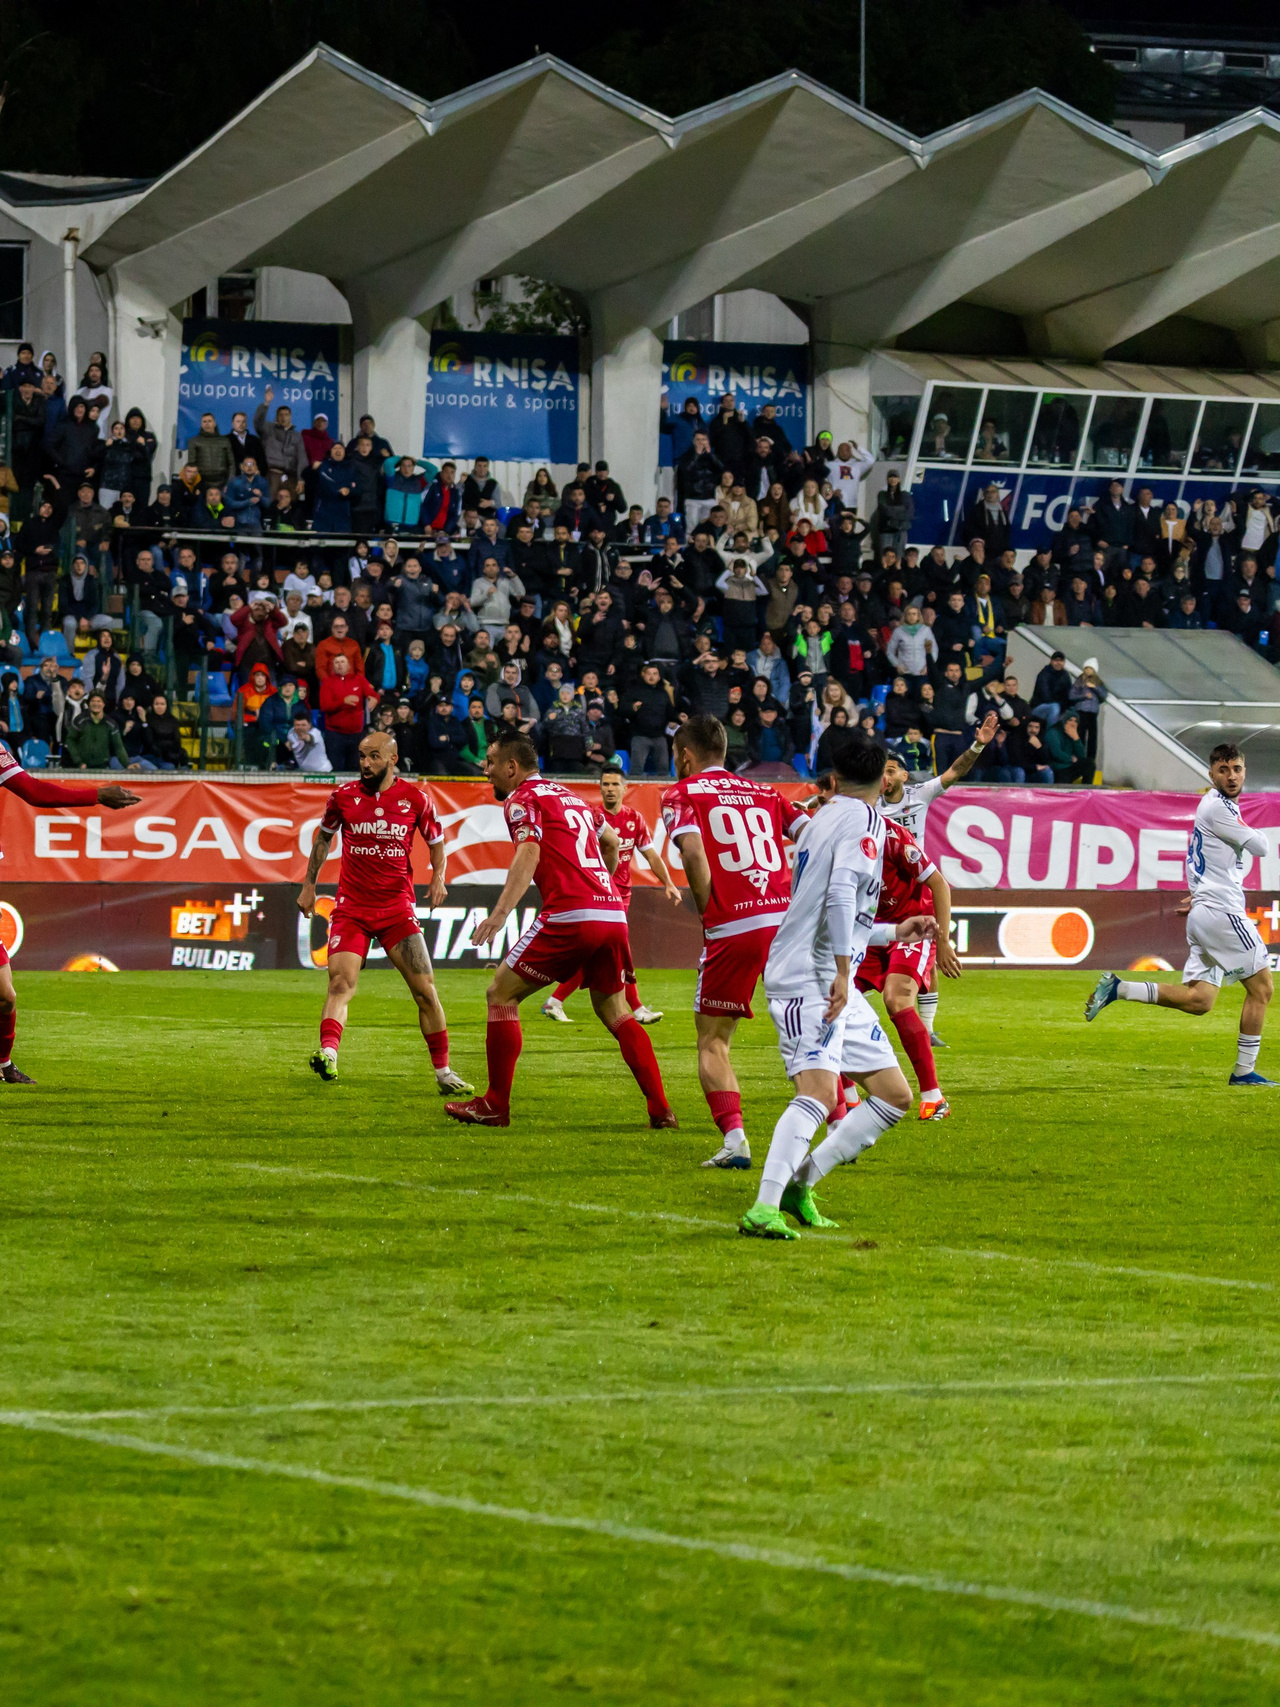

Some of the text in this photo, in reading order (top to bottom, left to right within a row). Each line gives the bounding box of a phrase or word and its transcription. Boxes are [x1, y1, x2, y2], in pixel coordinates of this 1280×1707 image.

[283, 386, 336, 402] sports
[506, 393, 517, 408] &
[524, 396, 576, 412] sports
[756, 403, 804, 418] sorts
[350, 819, 408, 837] WIN2.RO
[708, 806, 782, 872] 98
[176, 910, 217, 936] BET
[172, 946, 256, 972] BUILDER
[702, 997, 746, 1012] CARPATINA
